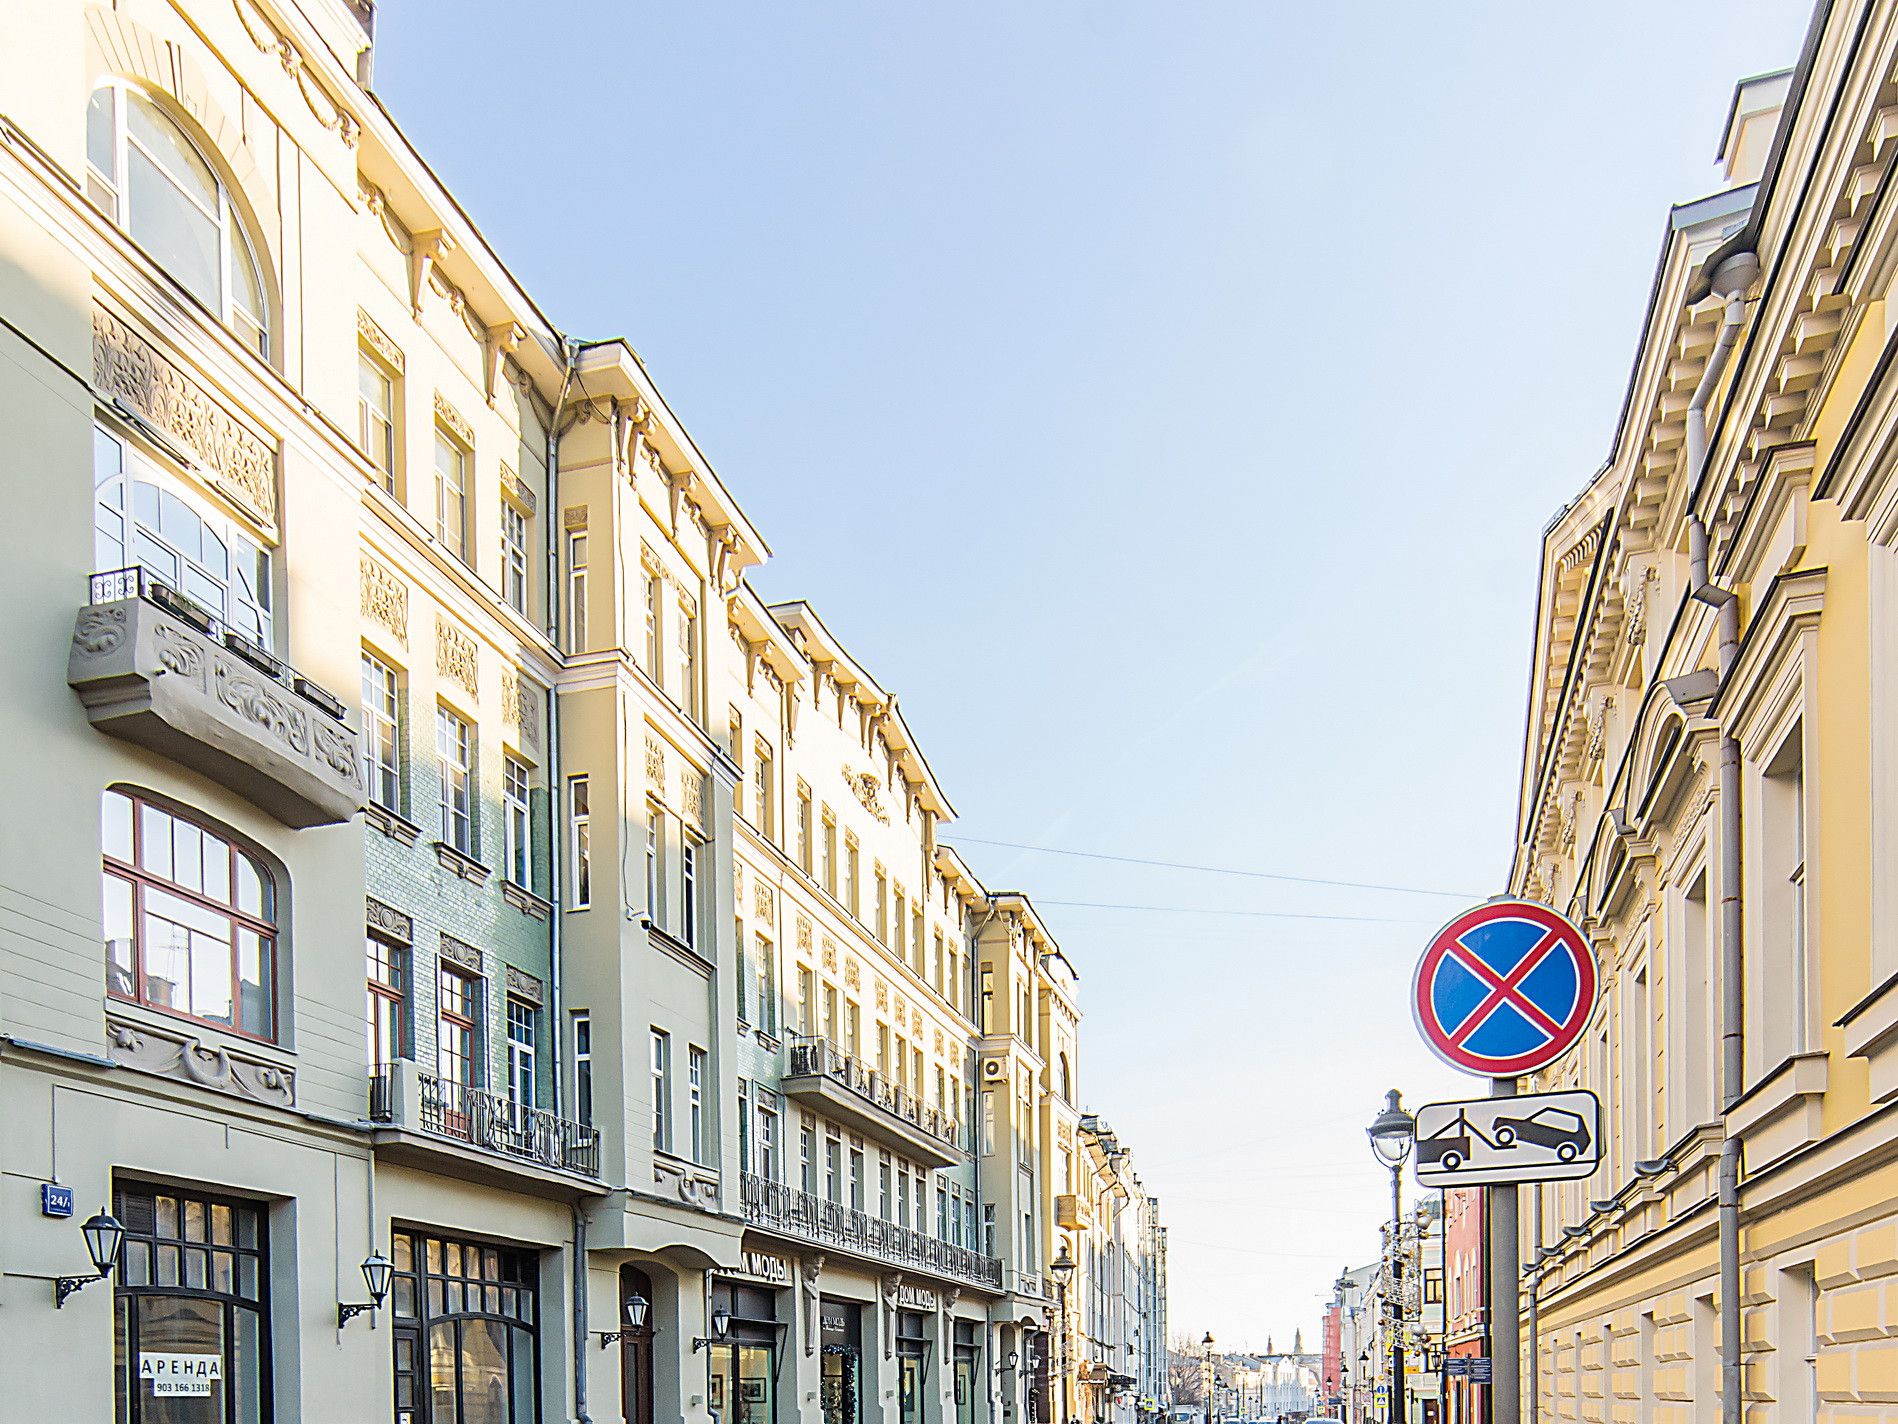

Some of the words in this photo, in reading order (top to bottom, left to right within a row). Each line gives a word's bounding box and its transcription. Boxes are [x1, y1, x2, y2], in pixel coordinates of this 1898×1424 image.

[751, 1252, 787, 1282] МОДЫ
[899, 1285, 915, 1304] ДОМ
[141, 1359, 219, 1377] АРЕНДА
[157, 1383, 172, 1392] 903
[174, 1383, 189, 1392] 166
[192, 1383, 210, 1392] 1318
